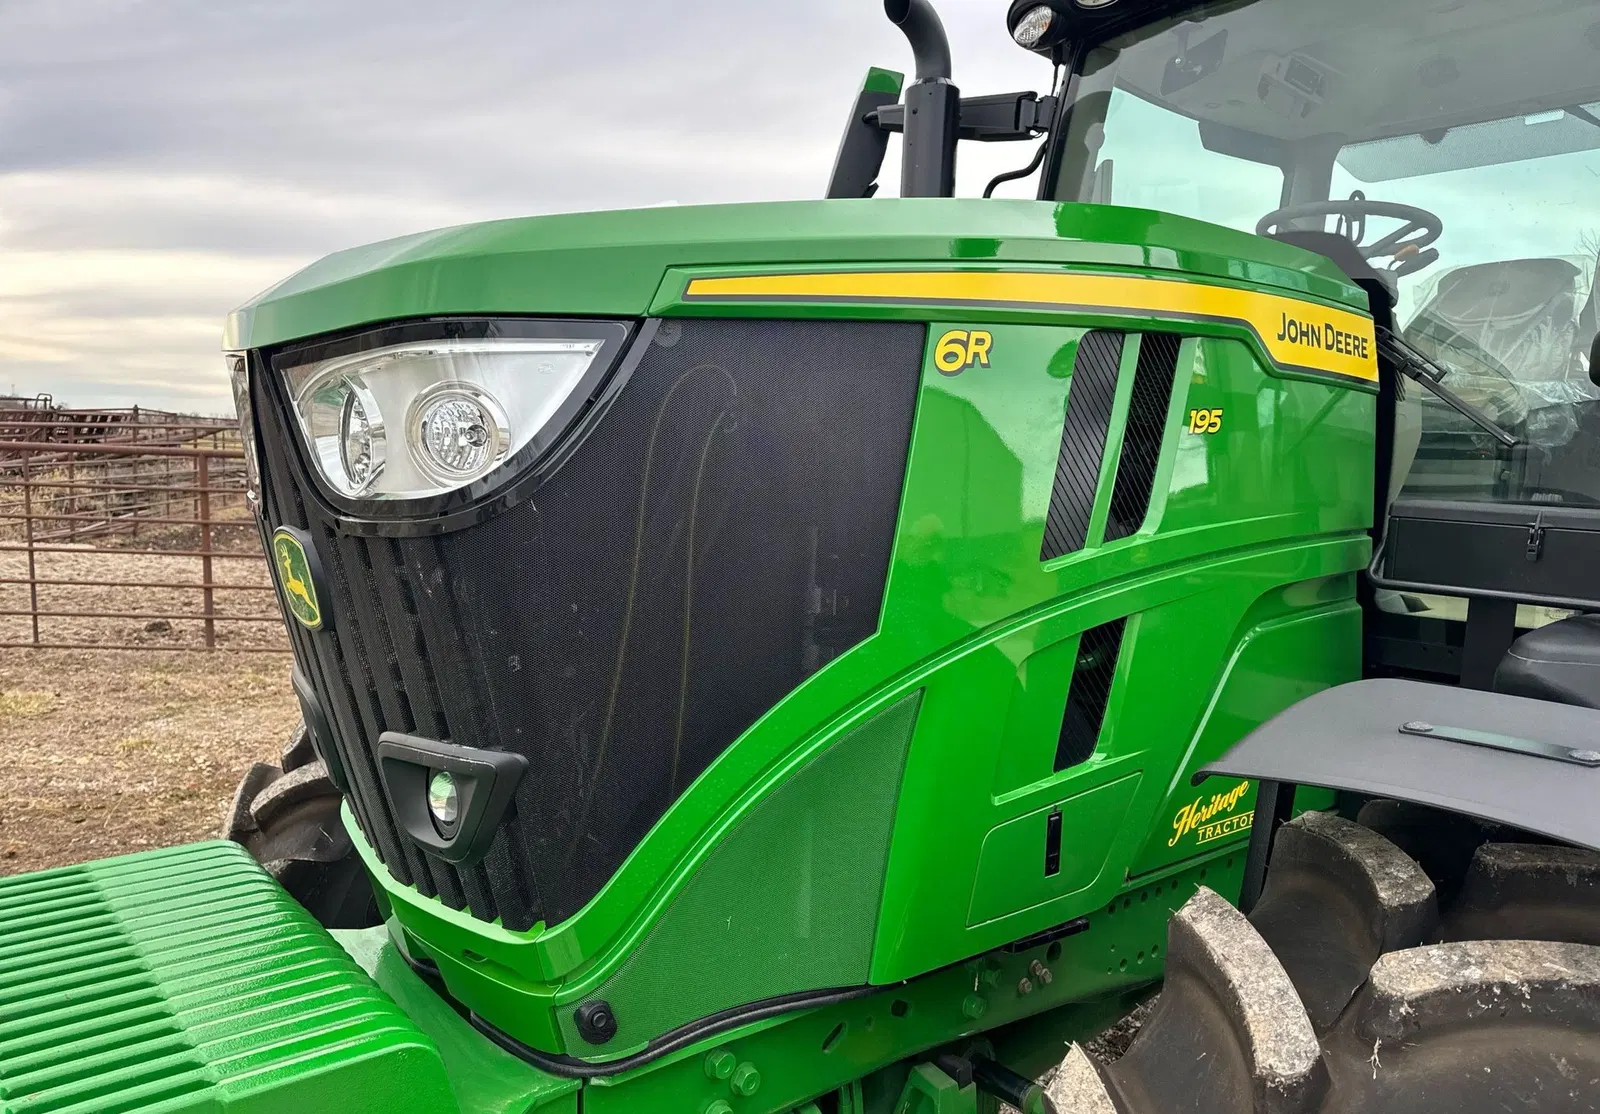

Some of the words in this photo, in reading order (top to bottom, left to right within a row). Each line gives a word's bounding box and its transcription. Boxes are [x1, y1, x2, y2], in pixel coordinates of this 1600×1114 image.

[934, 329, 993, 377] 6R
[1277, 312, 1321, 349] JOHN
[1324, 322, 1368, 360] DEERE
[1188, 408, 1223, 434] 195
[1168, 780, 1250, 847] Heritage
